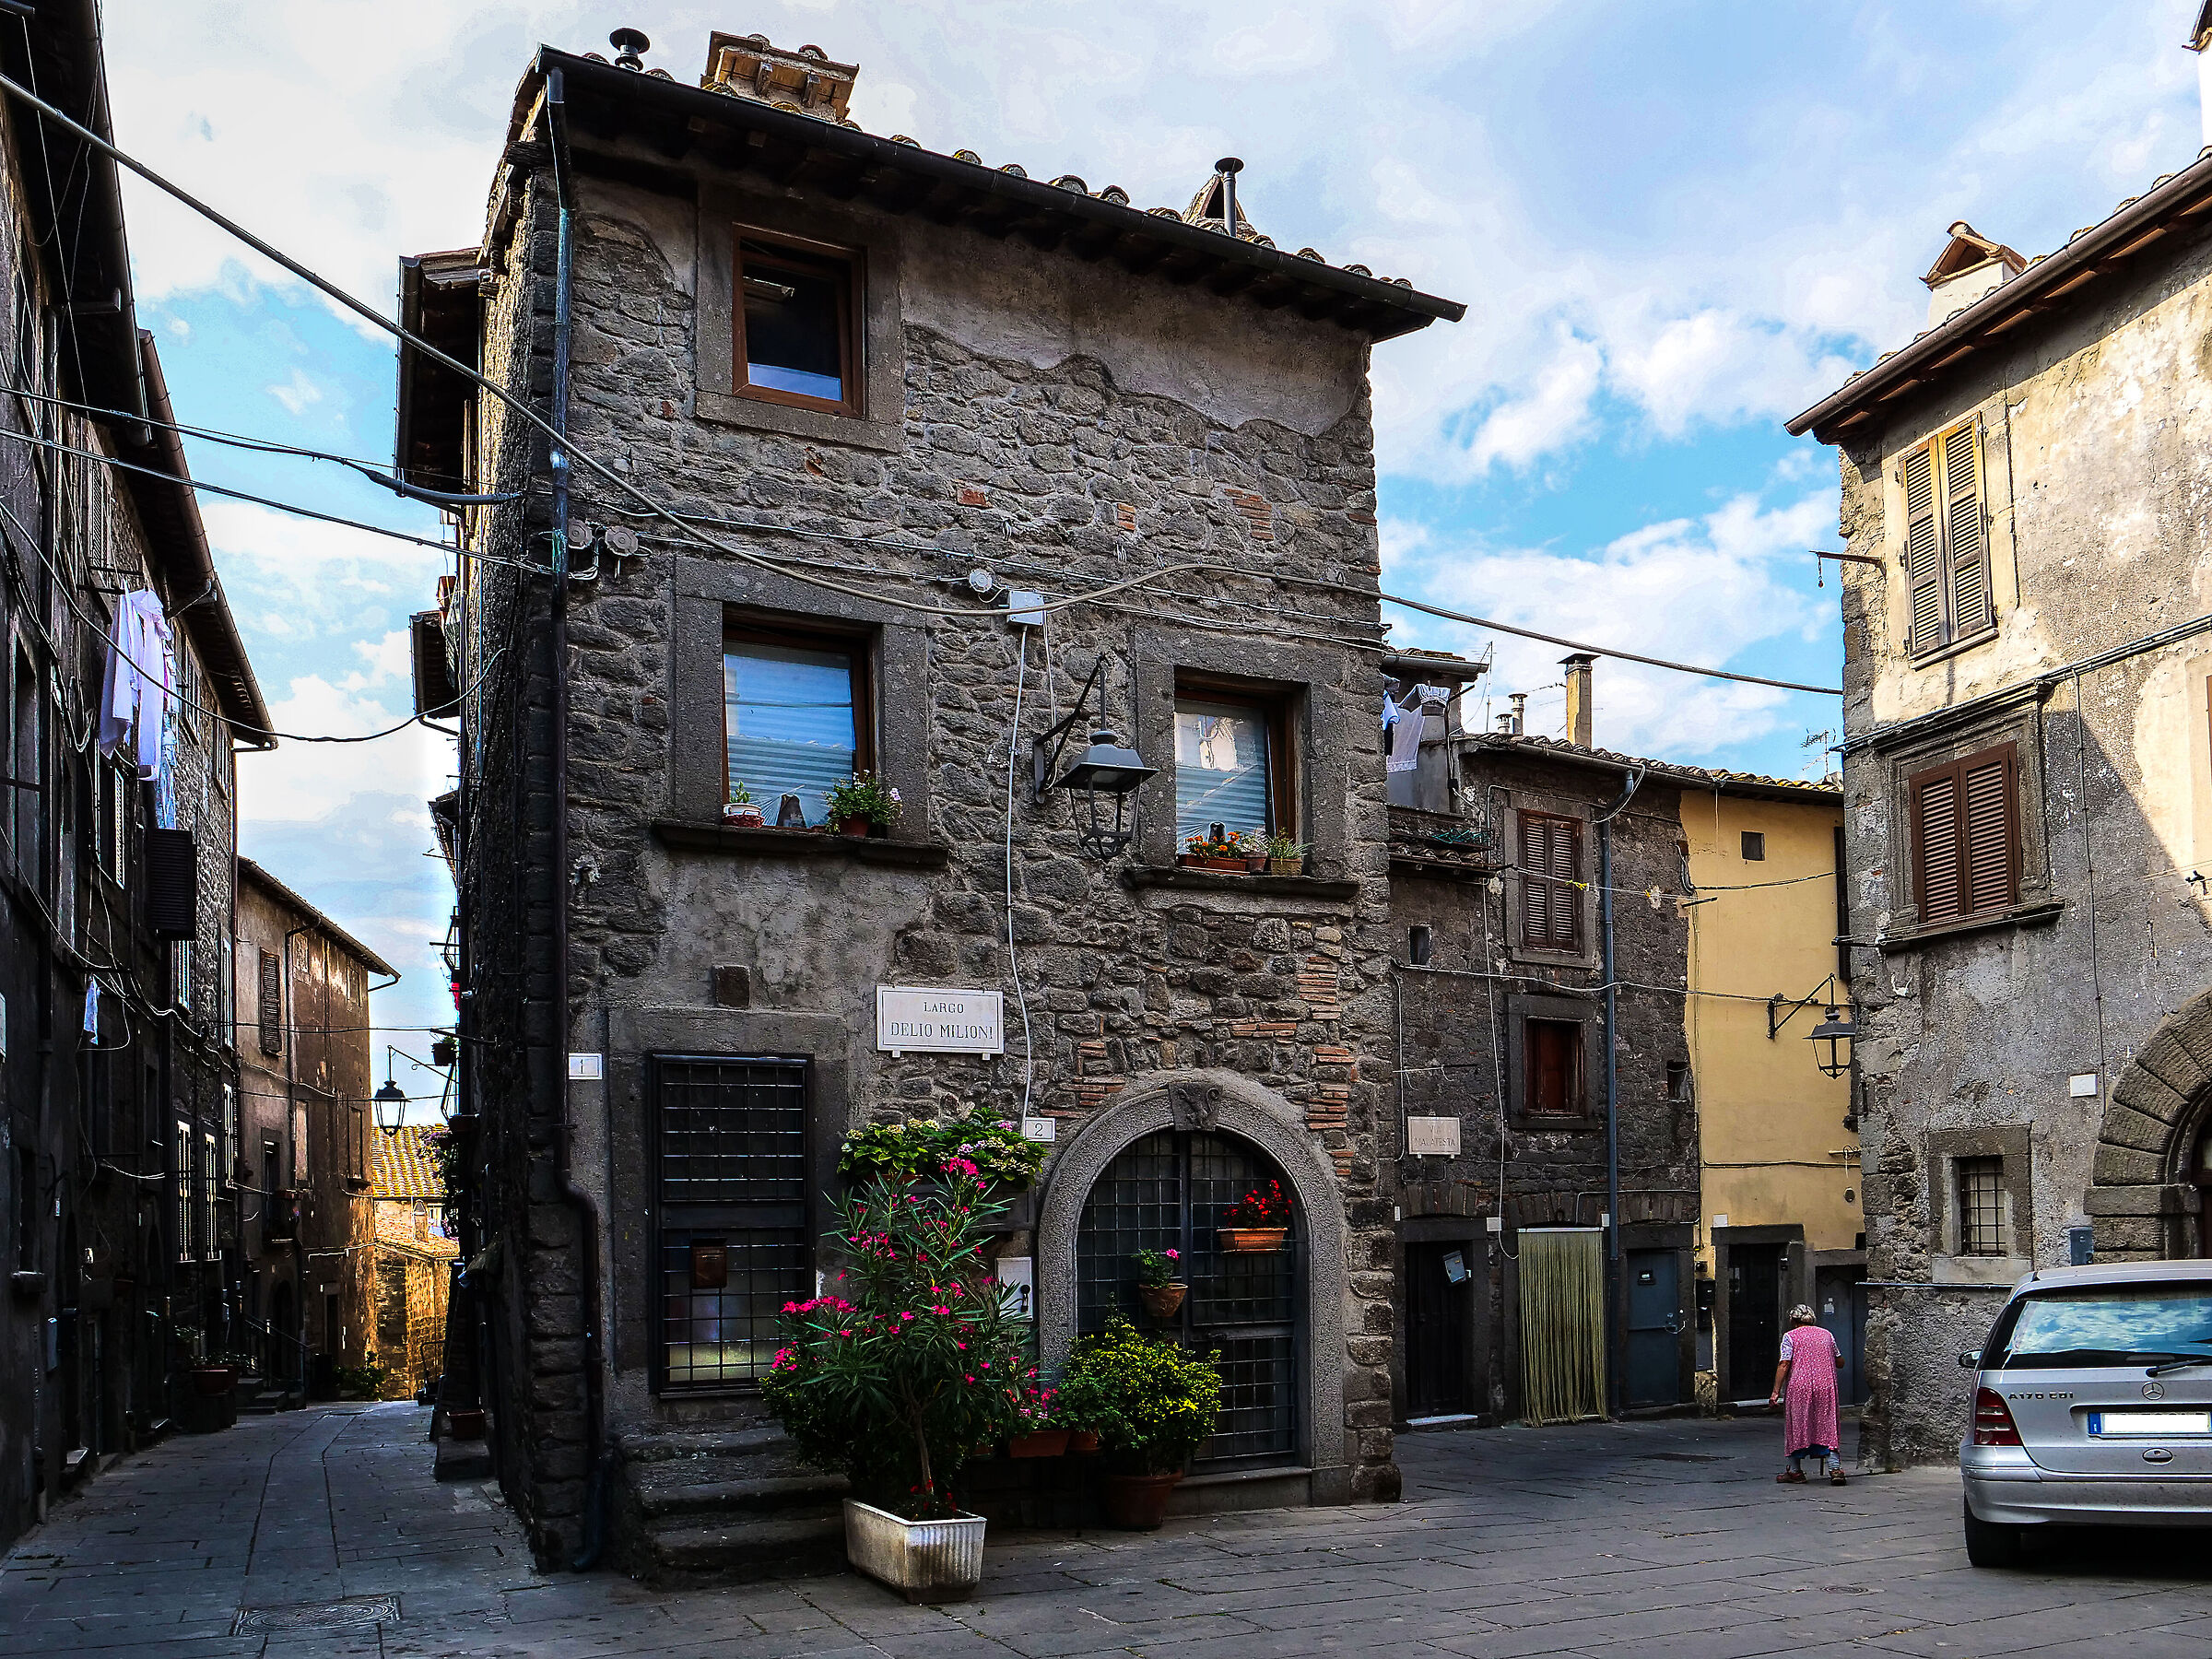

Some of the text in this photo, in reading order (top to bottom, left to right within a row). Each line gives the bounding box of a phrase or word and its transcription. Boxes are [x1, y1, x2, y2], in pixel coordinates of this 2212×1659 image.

[924, 1001, 964, 1014] LARGO
[890, 1022, 994, 1040] DELIO MILIONI
[579, 1059, 583, 1075] 1
[1034, 1123, 1043, 1136] 2
[1414, 1137, 1456, 1147] MALATESTA
